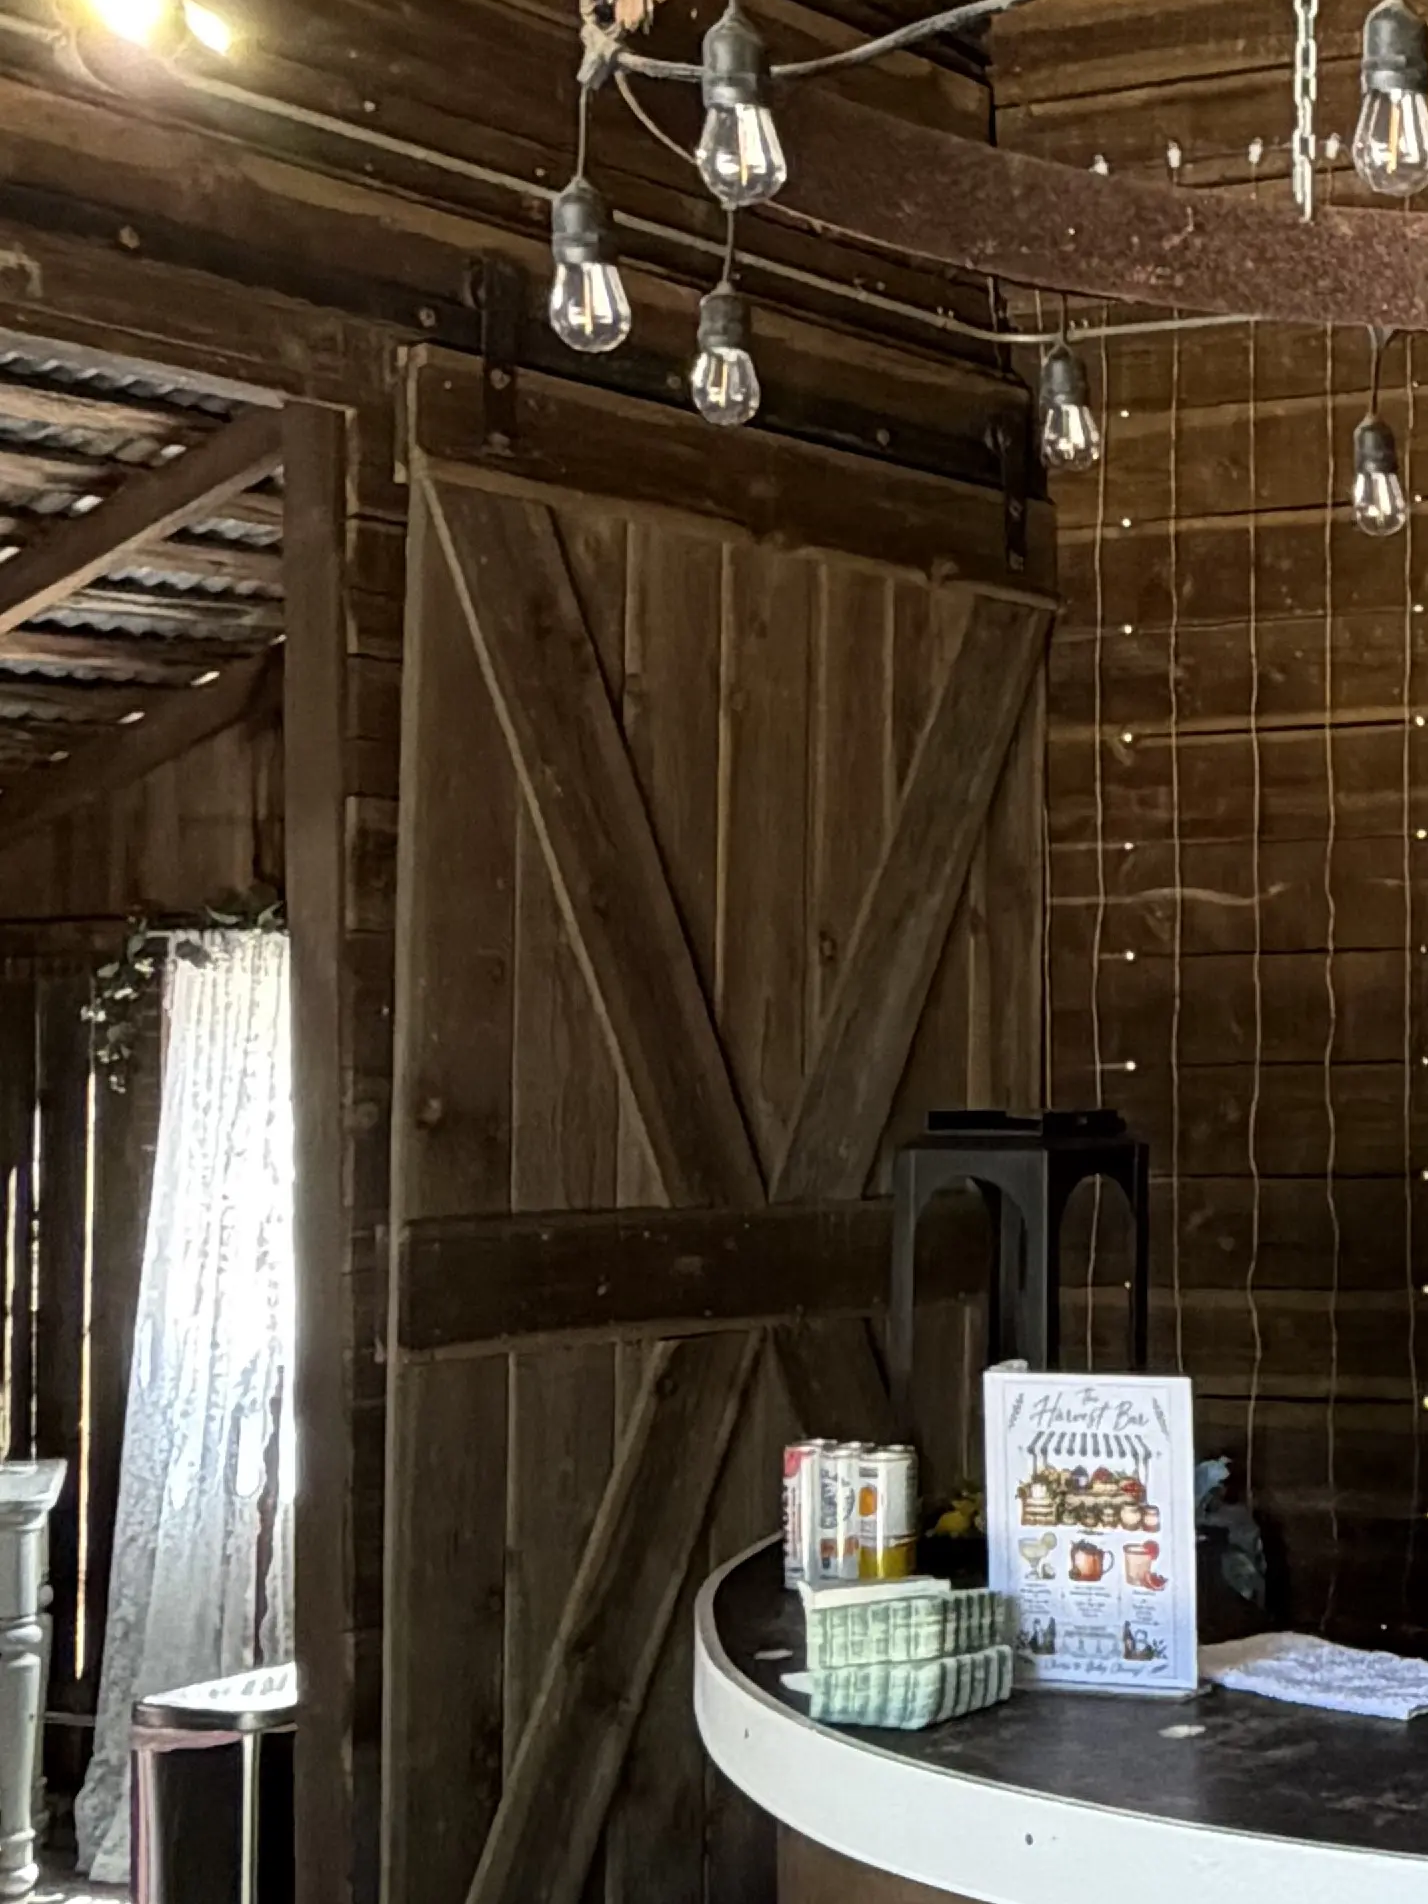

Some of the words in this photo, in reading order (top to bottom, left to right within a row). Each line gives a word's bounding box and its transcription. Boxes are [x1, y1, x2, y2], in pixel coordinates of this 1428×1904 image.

[1075, 1387, 1099, 1405] The
[1029, 1392, 1111, 1429] Harvest
[1113, 1400, 1149, 1431] Bar
